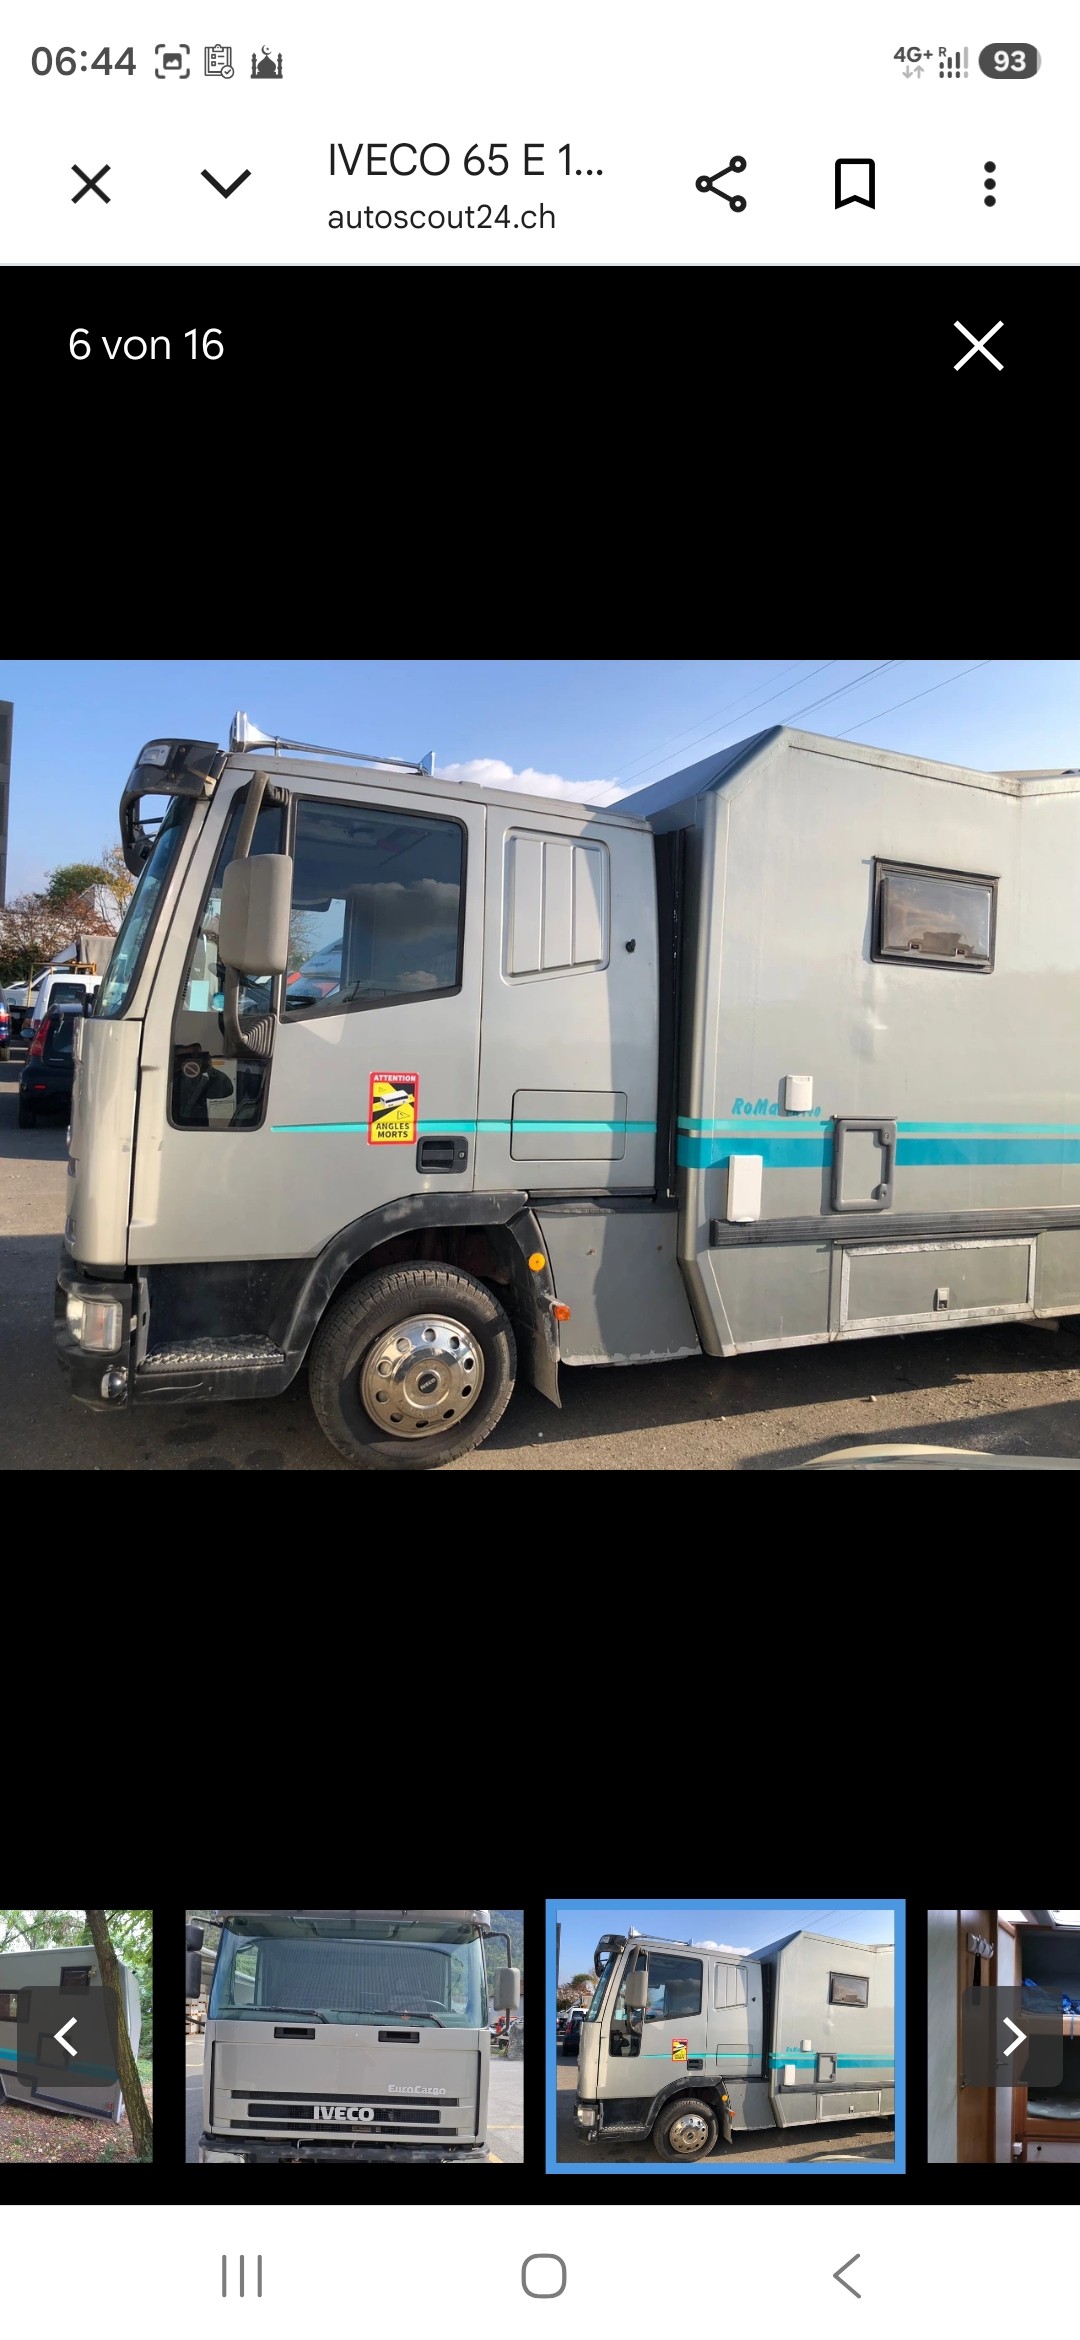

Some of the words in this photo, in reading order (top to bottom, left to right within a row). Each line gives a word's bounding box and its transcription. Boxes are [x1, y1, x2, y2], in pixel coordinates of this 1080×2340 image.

[31, 46, 137, 76] 06:44
[893, 46, 934, 63] 4G+
[993, 50, 1027, 72] 93
[330, 142, 451, 177] IVECO
[463, 143, 509, 177] 65
[524, 143, 545, 176] E
[328, 202, 556, 230] autoscout24.ch
[69, 327, 91, 361] 6
[101, 335, 171, 361] von
[184, 328, 224, 361] 16
[373, 1074, 416, 1082] ATTENTION
[375, 1122, 410, 1130] ANGLES
[377, 1130, 409, 1138] MORTS
[387, 2084, 447, 2096] EuroCargo
[313, 2105, 375, 2122] IVECO
